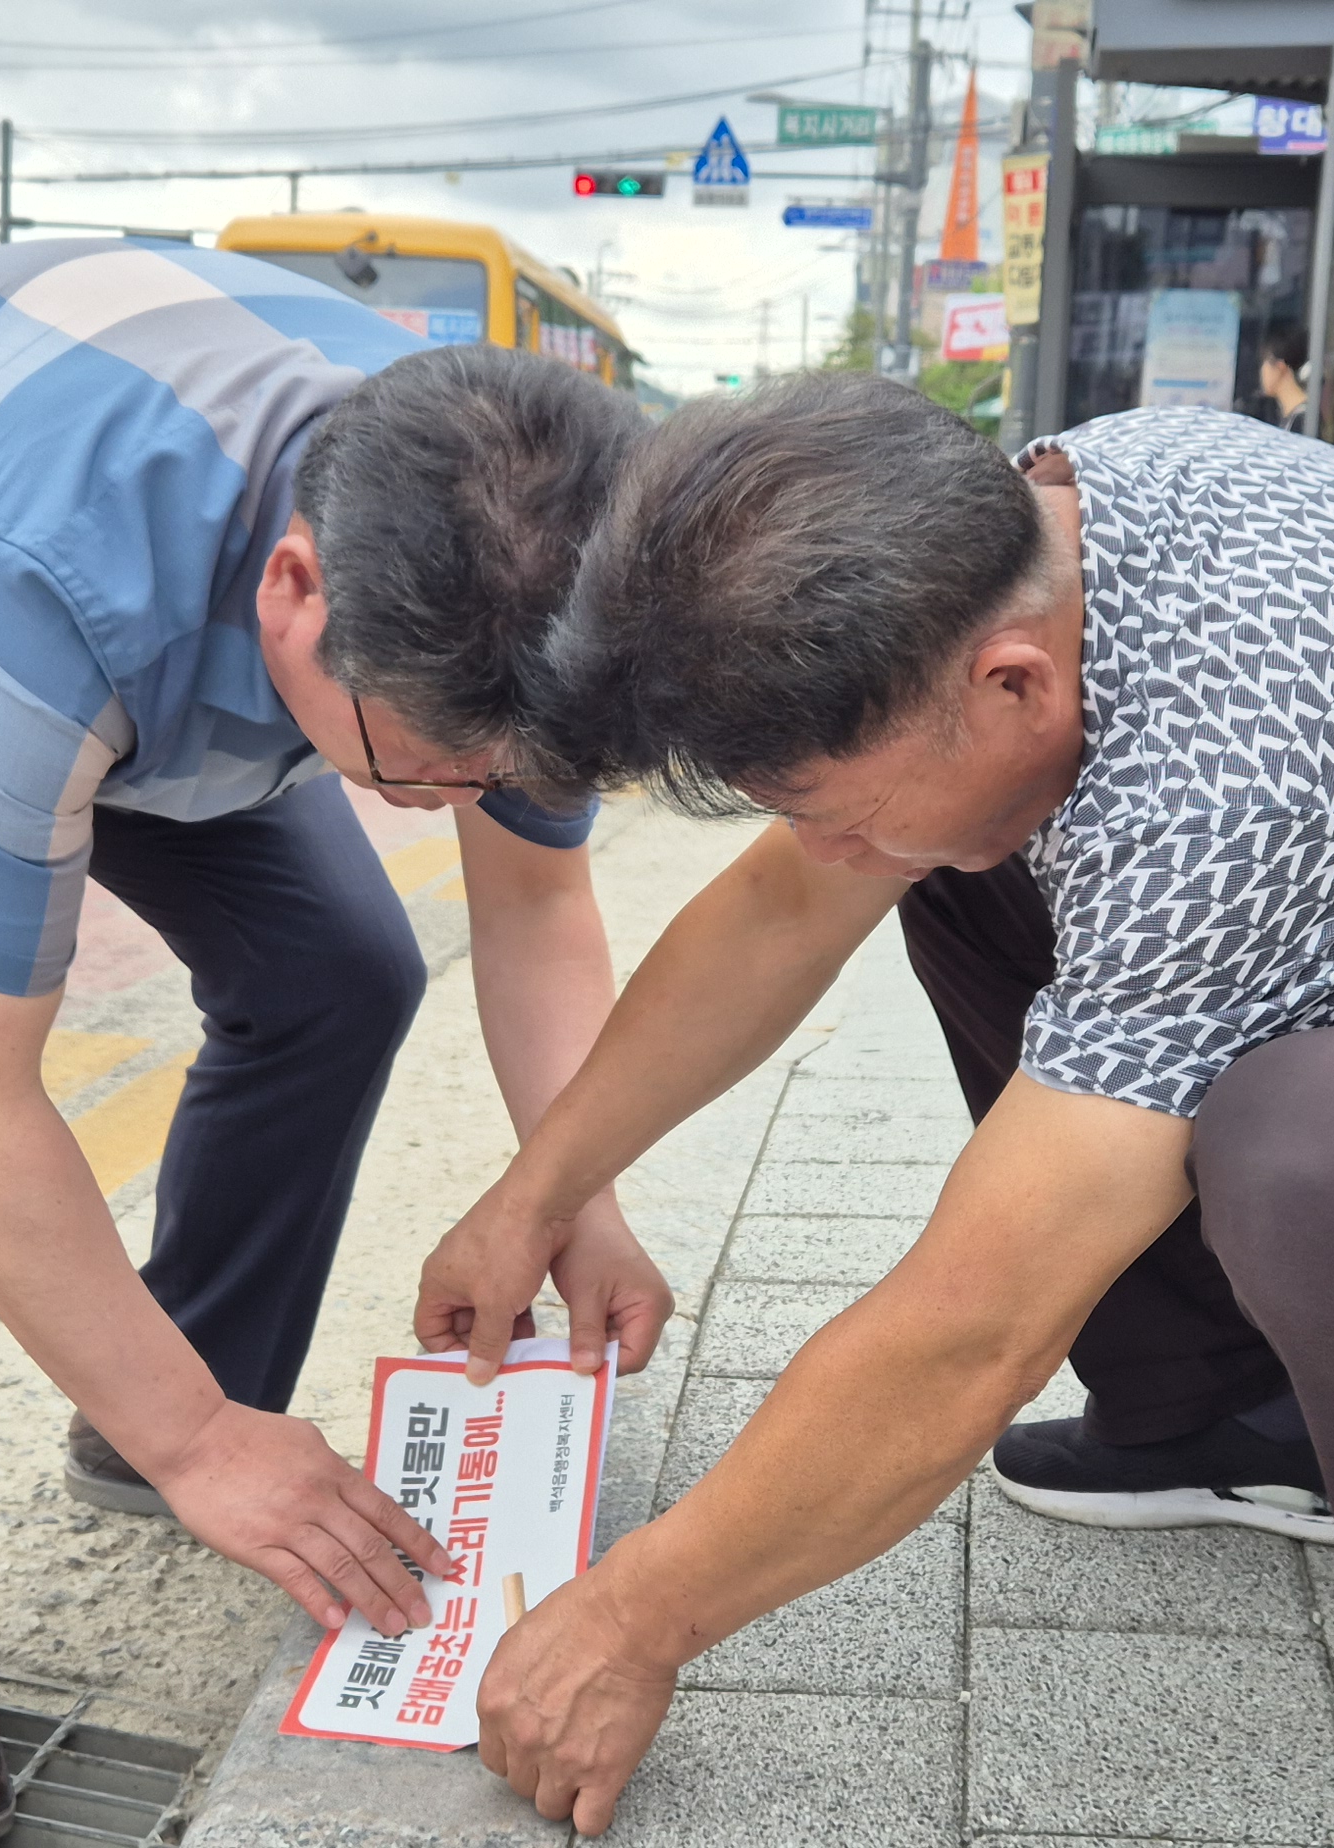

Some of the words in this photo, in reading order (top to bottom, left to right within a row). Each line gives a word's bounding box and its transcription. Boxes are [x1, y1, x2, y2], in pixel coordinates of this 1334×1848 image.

[400, 1402, 449, 1505] 빗물만
[548, 1393, 576, 1514] 백석읍행정복지센터
[395, 1597, 478, 1726] 담배꽁초는
